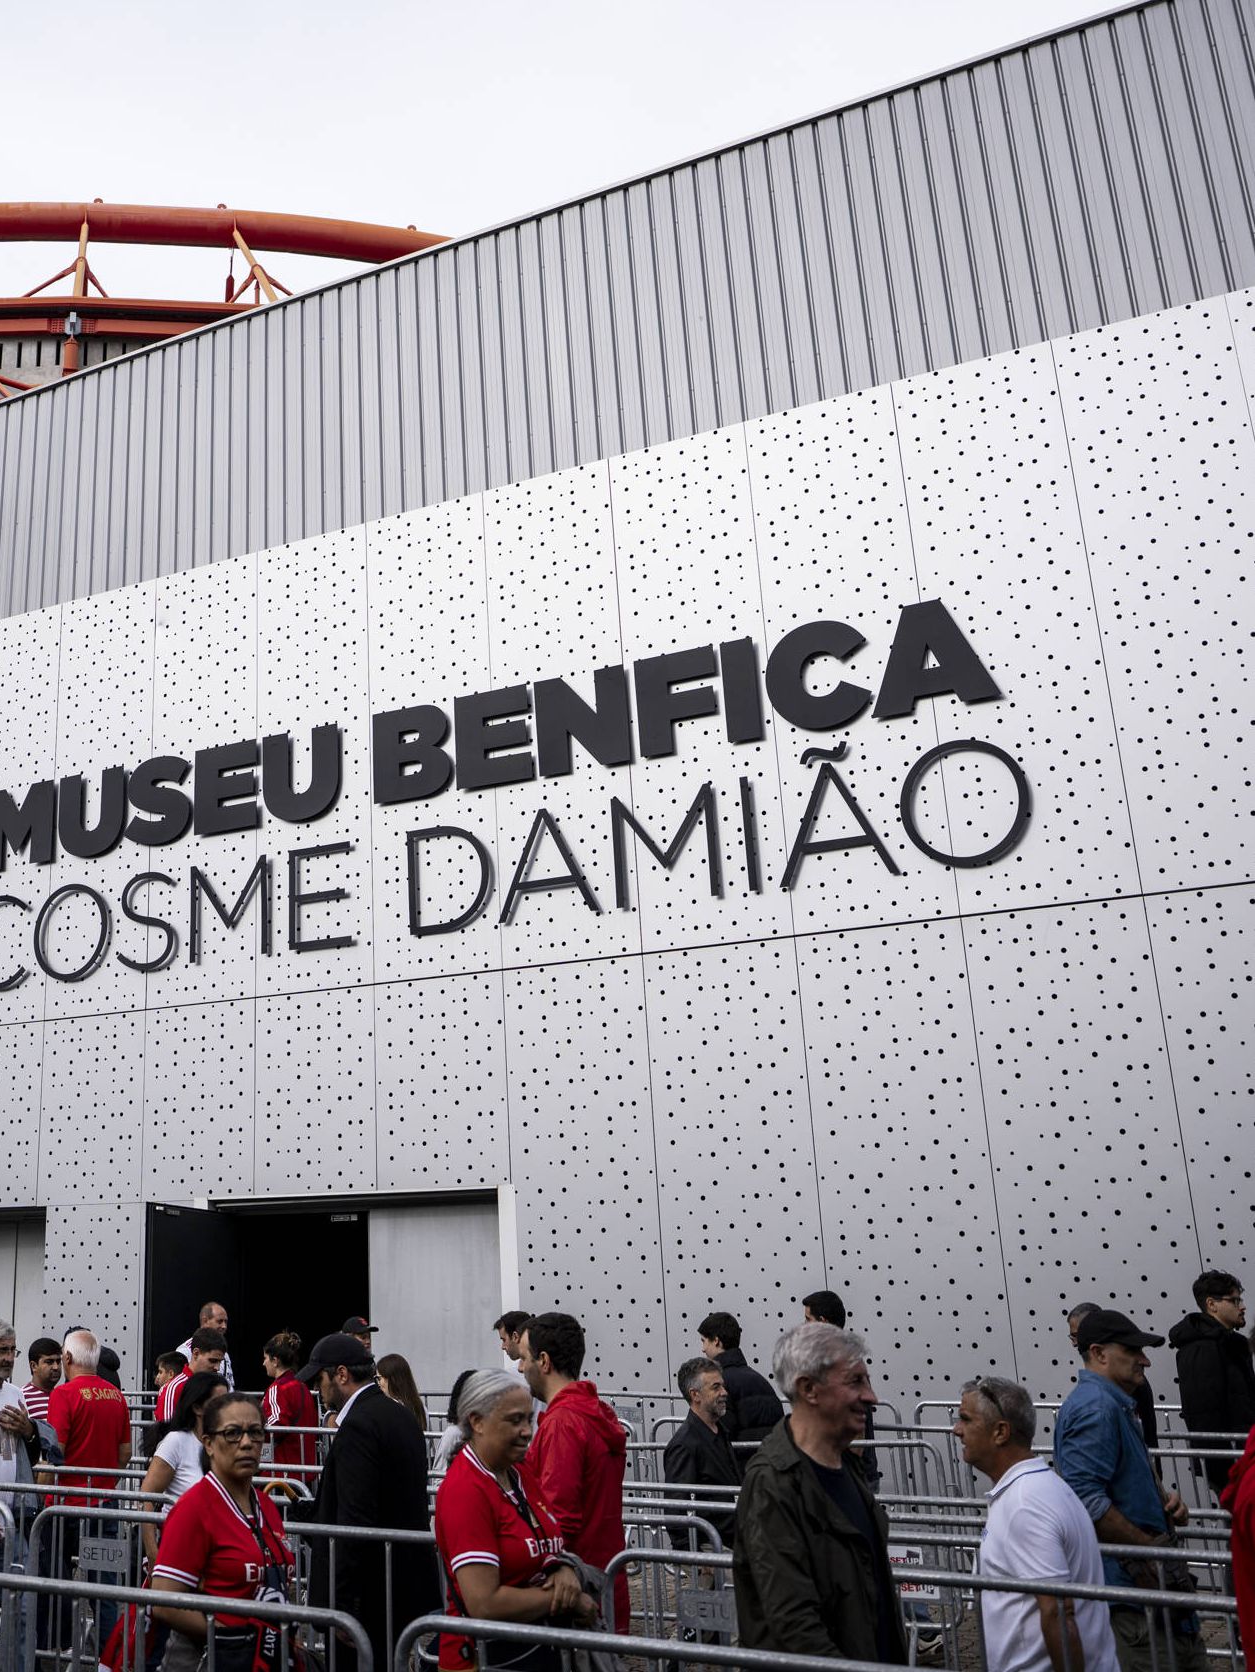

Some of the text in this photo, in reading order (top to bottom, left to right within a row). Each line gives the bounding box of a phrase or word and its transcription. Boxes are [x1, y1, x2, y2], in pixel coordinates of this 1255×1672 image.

[370, 598, 1003, 804] BENFICA
[406, 738, 1032, 938] DAMIÃO
[83, 1546, 123, 1562] SETUP
[901, 1582, 935, 1593] SETUP
[684, 1600, 730, 1620] SETU
